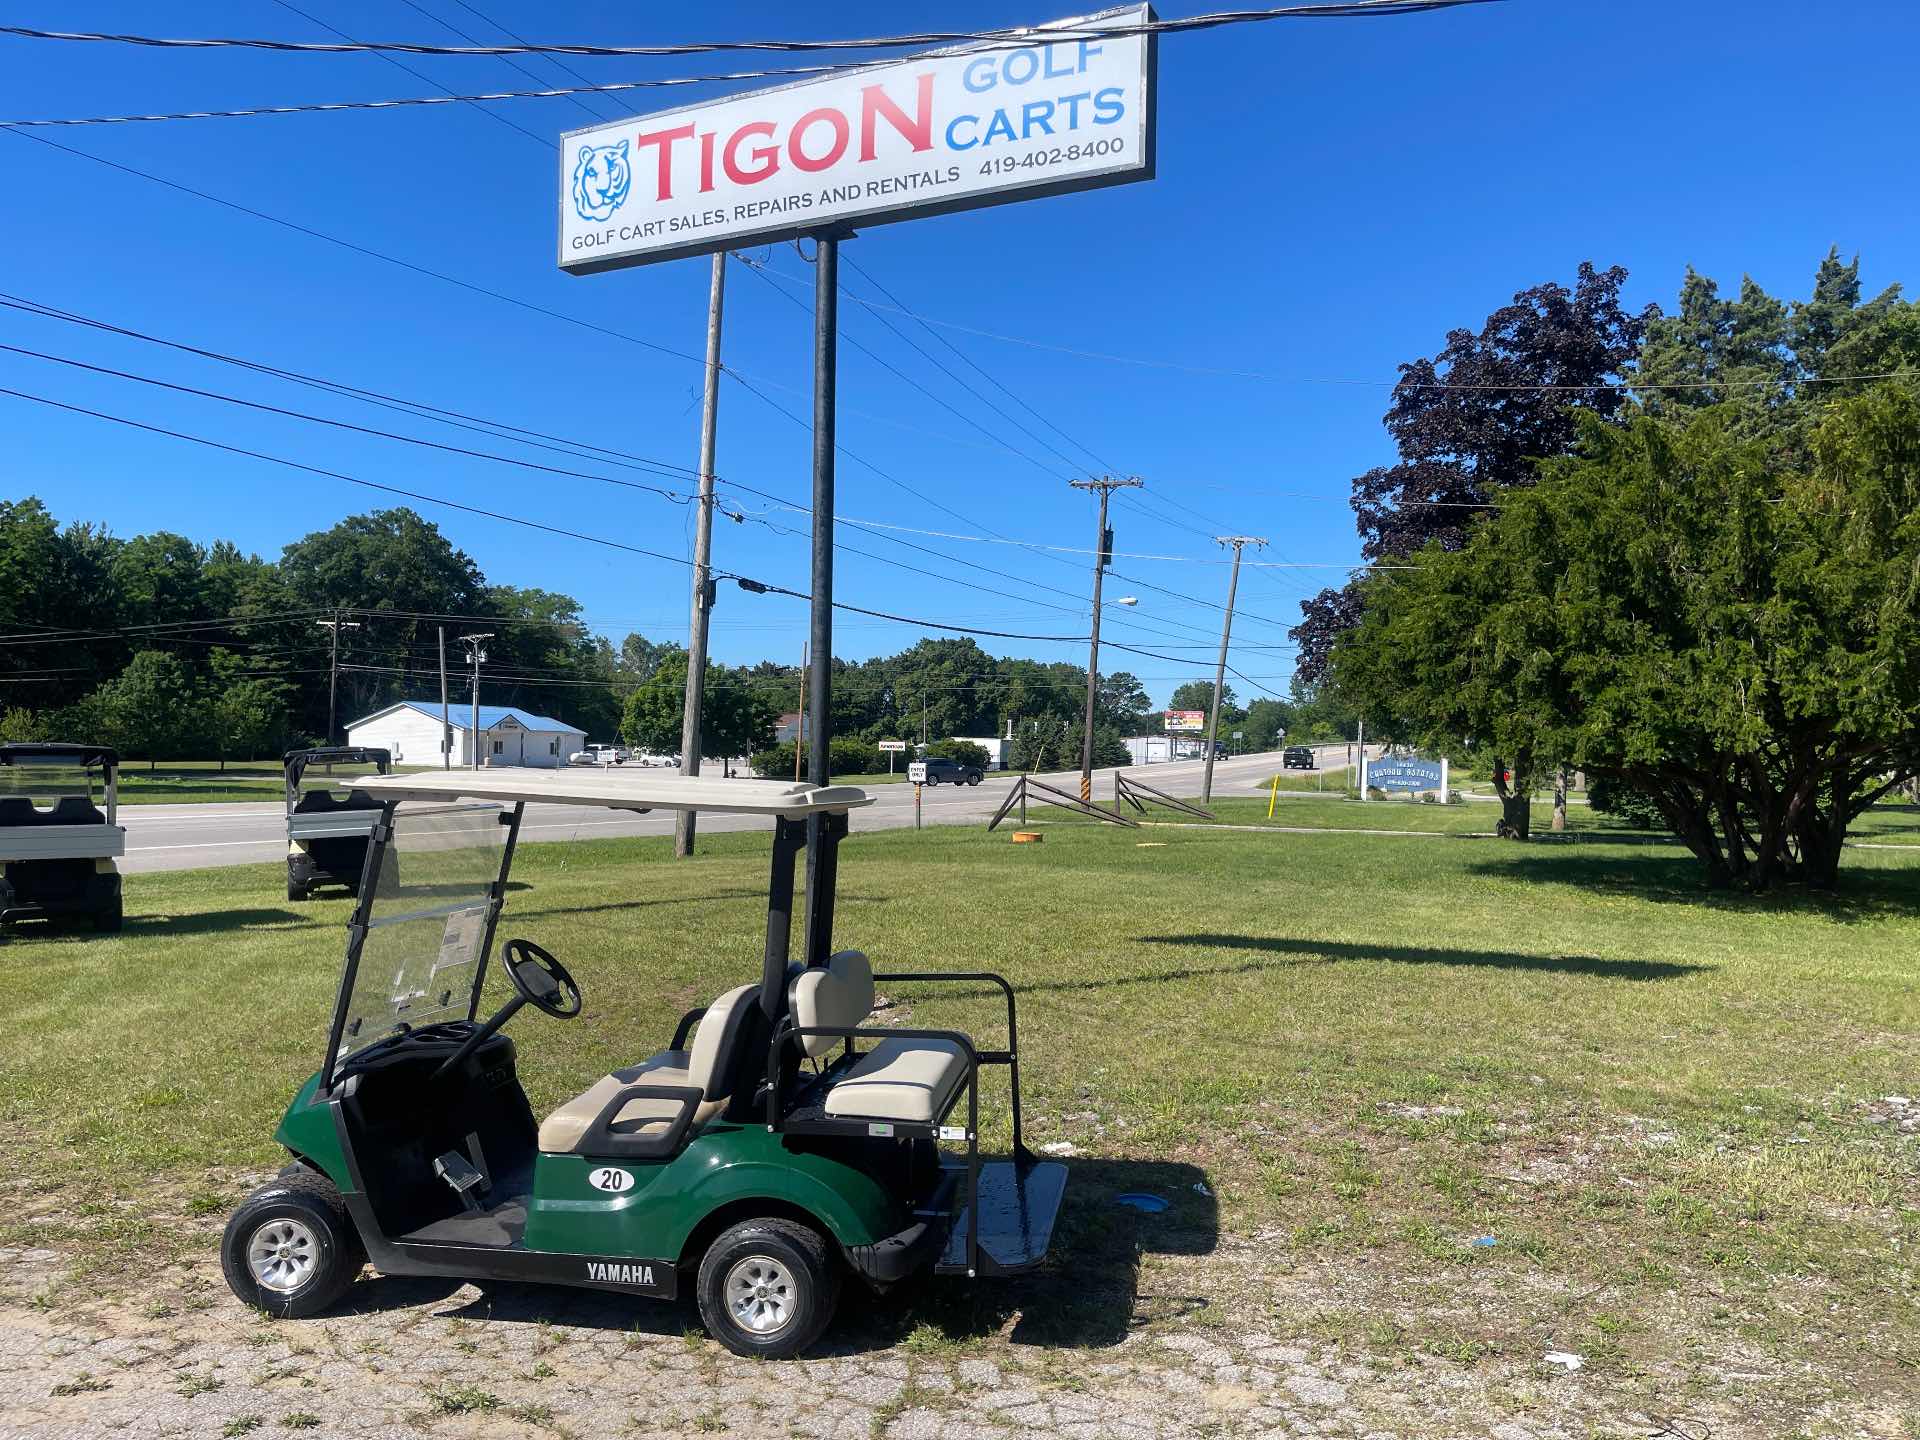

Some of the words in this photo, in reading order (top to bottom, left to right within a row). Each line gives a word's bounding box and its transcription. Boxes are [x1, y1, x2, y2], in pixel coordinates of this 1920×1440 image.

[963, 39, 1103, 93] GOLF
[945, 87, 1125, 151] CARTS
[979, 137, 1124, 176] 419-402-8400
[572, 229, 616, 250] GOLF
[619, 220, 666, 241] CART
[669, 209, 730, 232] SALES,
[734, 193, 813, 221] REPAIRS
[819, 185, 861, 205] AND
[866, 166, 960, 197] RENTALS
[601, 1170, 622, 1190] 20
[586, 1262, 654, 1284] YAMAHA
